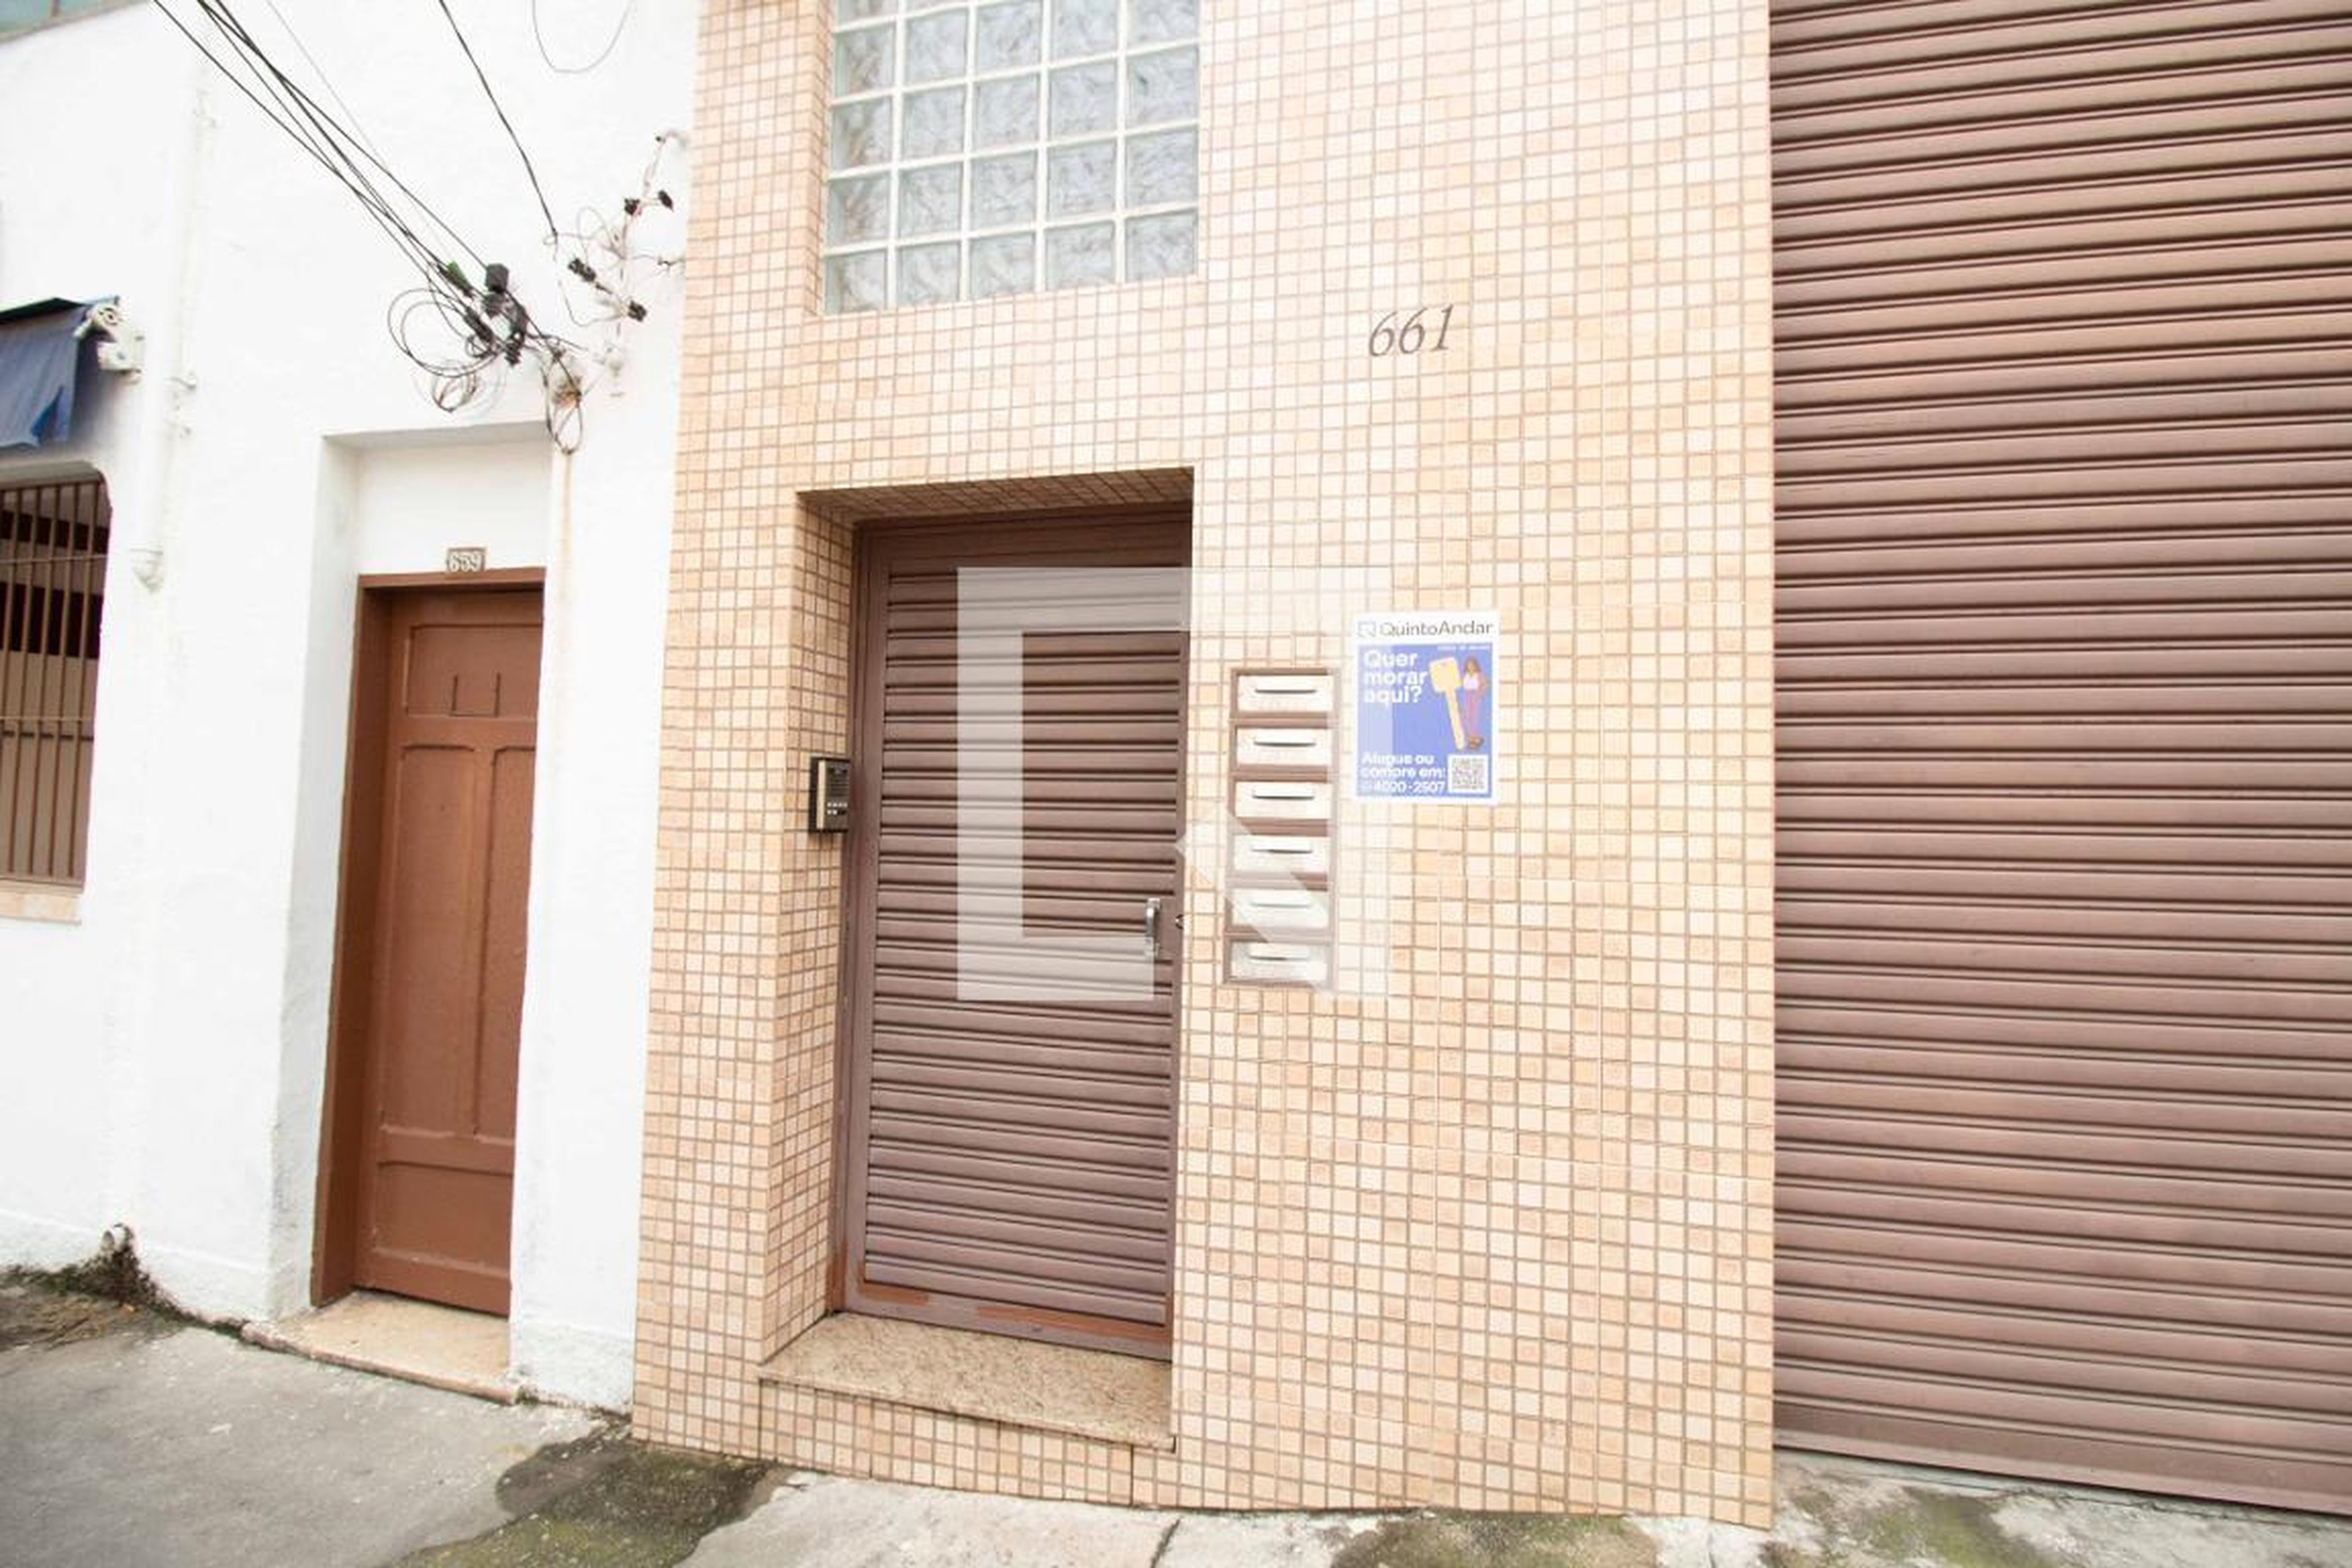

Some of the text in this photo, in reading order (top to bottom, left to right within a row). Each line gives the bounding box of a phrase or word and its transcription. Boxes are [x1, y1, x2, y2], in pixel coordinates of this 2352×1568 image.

[1369, 304, 1453, 357] 661
[450, 551, 481, 572] 659
[1379, 620, 1493, 637] QuintoAndar
[1363, 650, 1418, 666] Quer
[1363, 671, 1427, 685] morar
[1363, 685, 1422, 707] aqui?
[1415, 755, 1434, 764] ou
